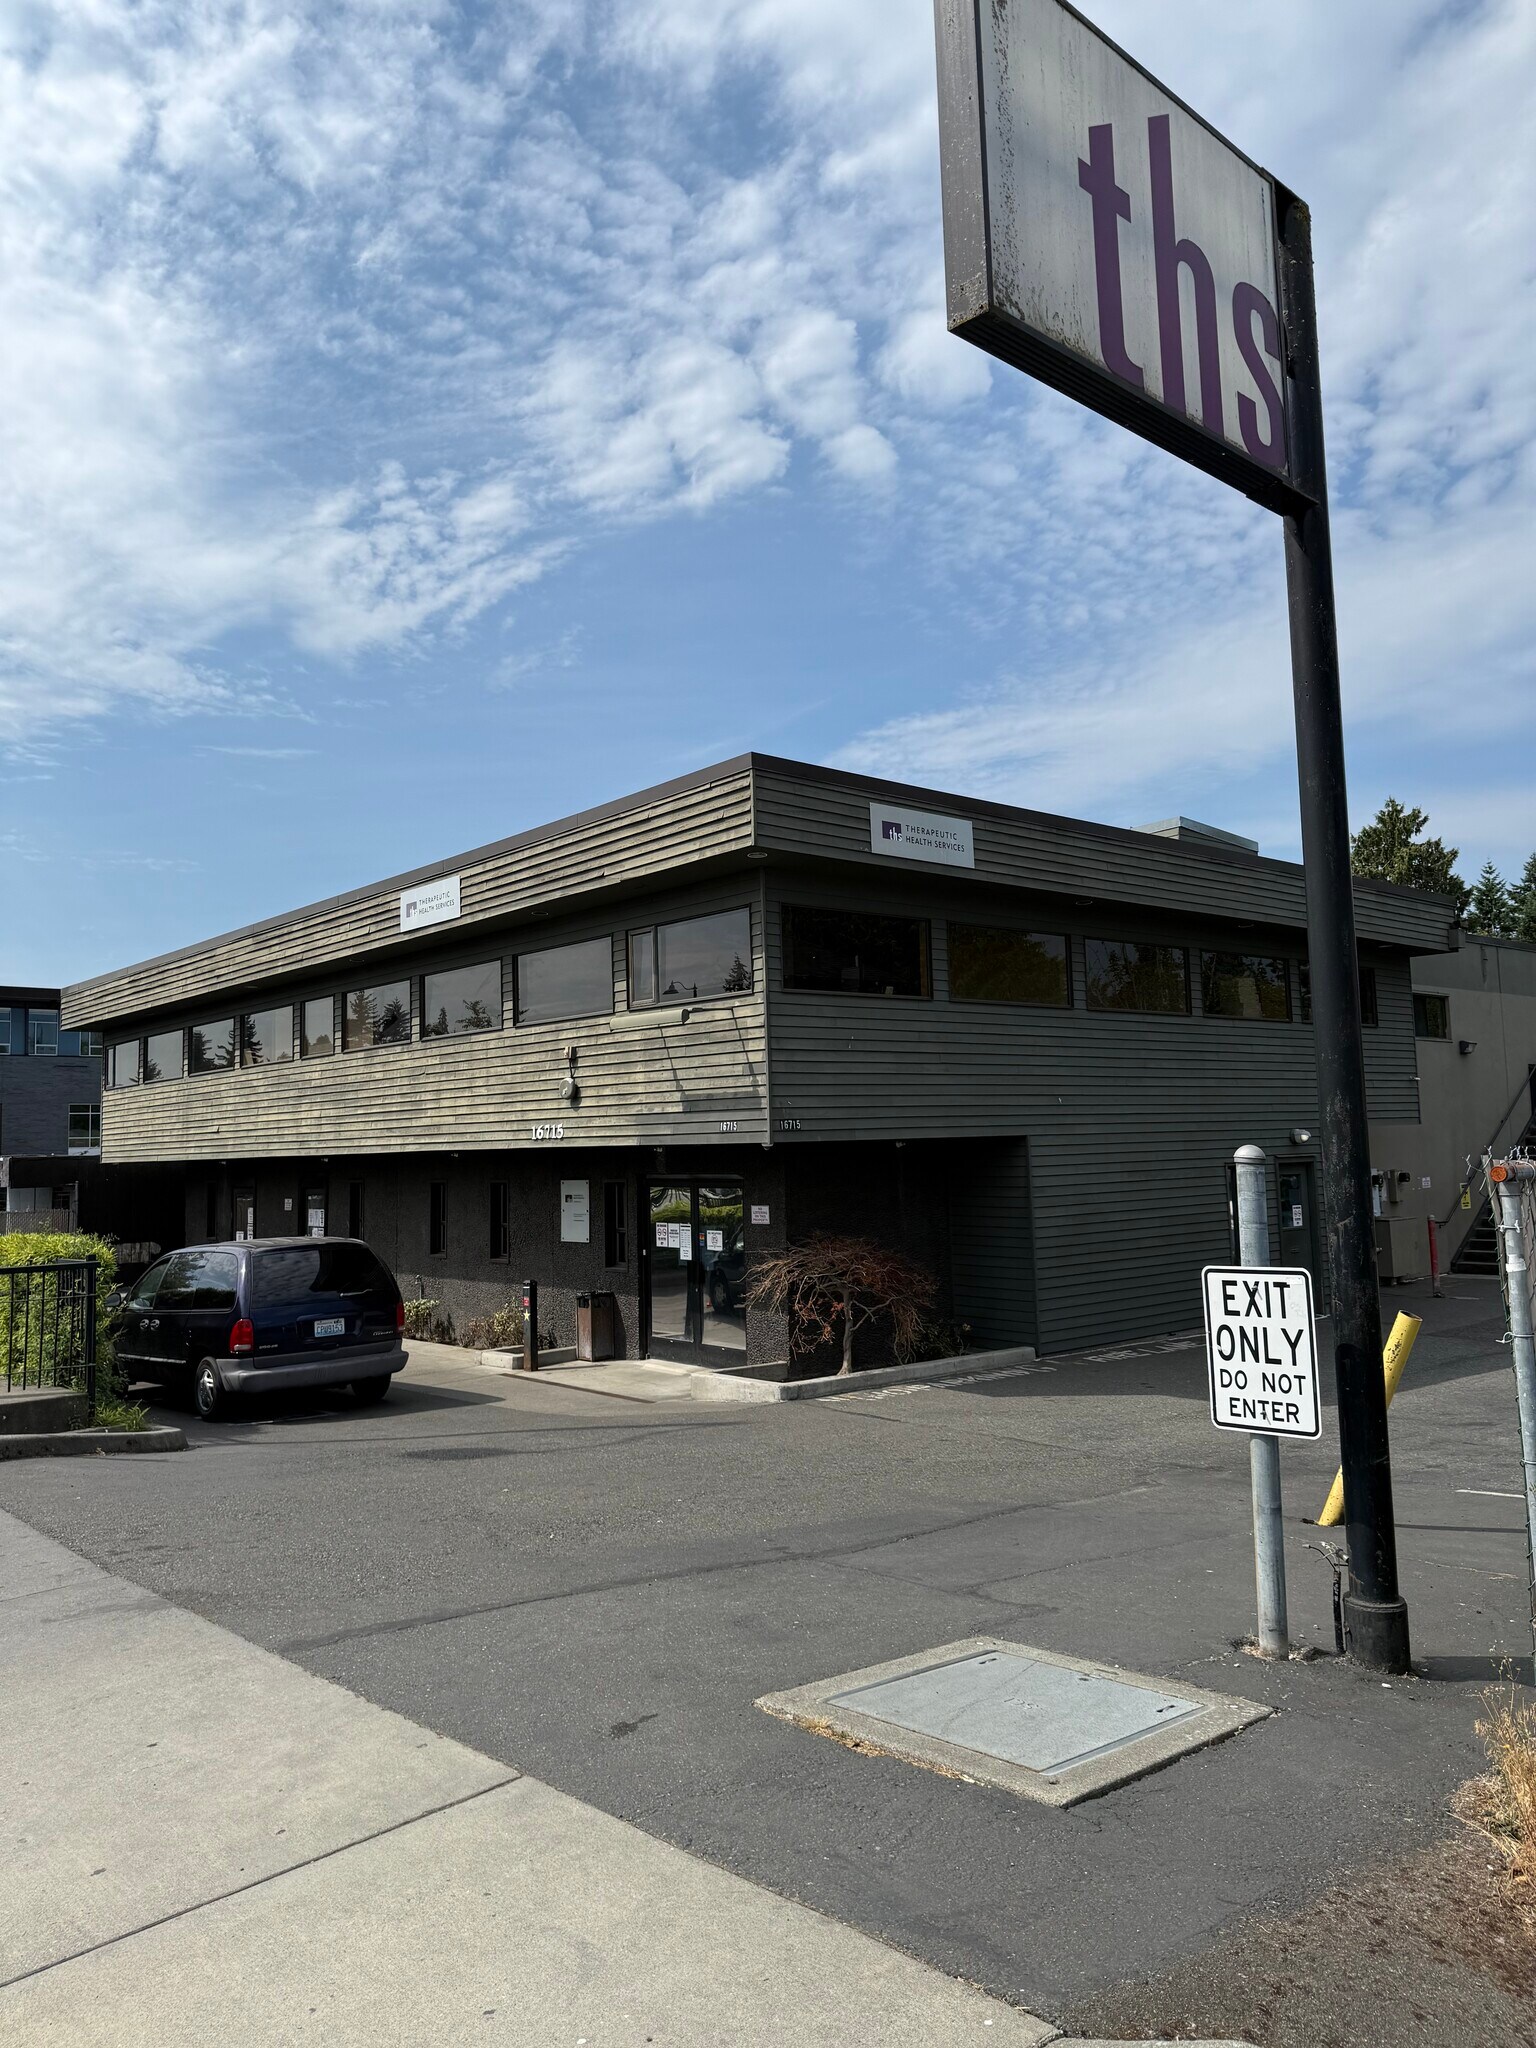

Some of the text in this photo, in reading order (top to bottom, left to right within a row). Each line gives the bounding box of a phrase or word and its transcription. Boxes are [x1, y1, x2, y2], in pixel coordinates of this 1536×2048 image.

[1078, 114, 1285, 468] ths
[889, 827, 902, 841] ths
[905, 824, 957, 840] THERAPEUTIC
[905, 836, 965, 852] HEALTH SERVICES
[531, 1123, 564, 1140] 16715
[720, 1121, 737, 1131] 16715
[780, 1120, 801, 1130] 16715
[1222, 1280, 1290, 1318] EXIT
[1217, 1324, 1304, 1366] ONLY
[1220, 1369, 1306, 1395] DO NOT
[1230, 1397, 1300, 1423] ENTER
